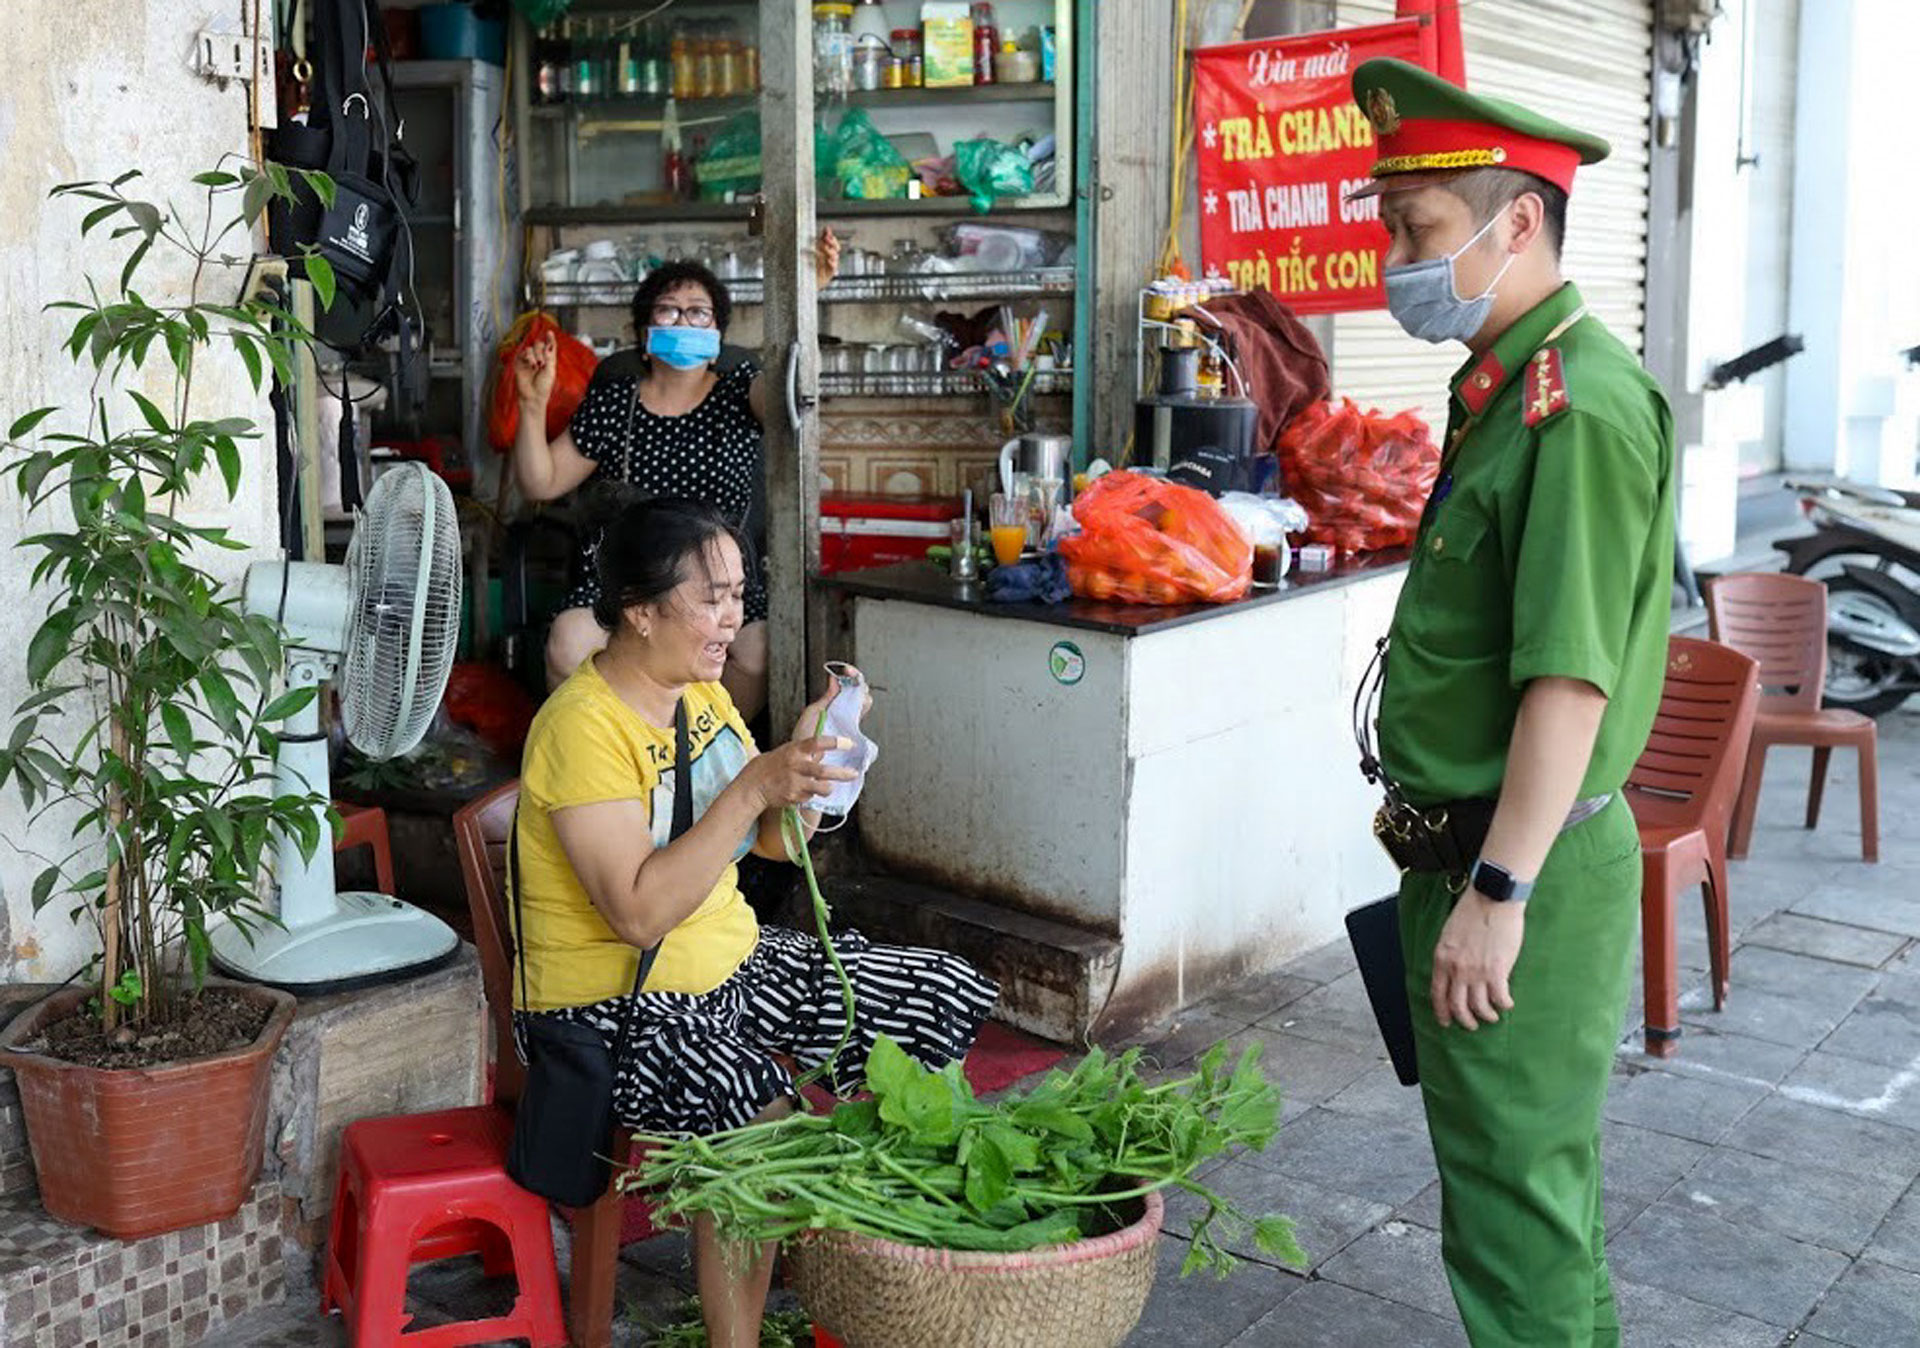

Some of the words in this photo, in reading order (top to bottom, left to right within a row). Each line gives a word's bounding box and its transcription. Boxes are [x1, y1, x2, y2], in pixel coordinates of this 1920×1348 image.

[1219, 102, 1275, 161] TRÀ
[1278, 103, 1374, 156] CHANH
[1226, 180, 1264, 233] TRÀ
[1265, 182, 1330, 230] CHANH
[1226, 249, 1272, 294] TRÀ
[1276, 236, 1320, 293] TẮC
[1324, 249, 1378, 290] CON
